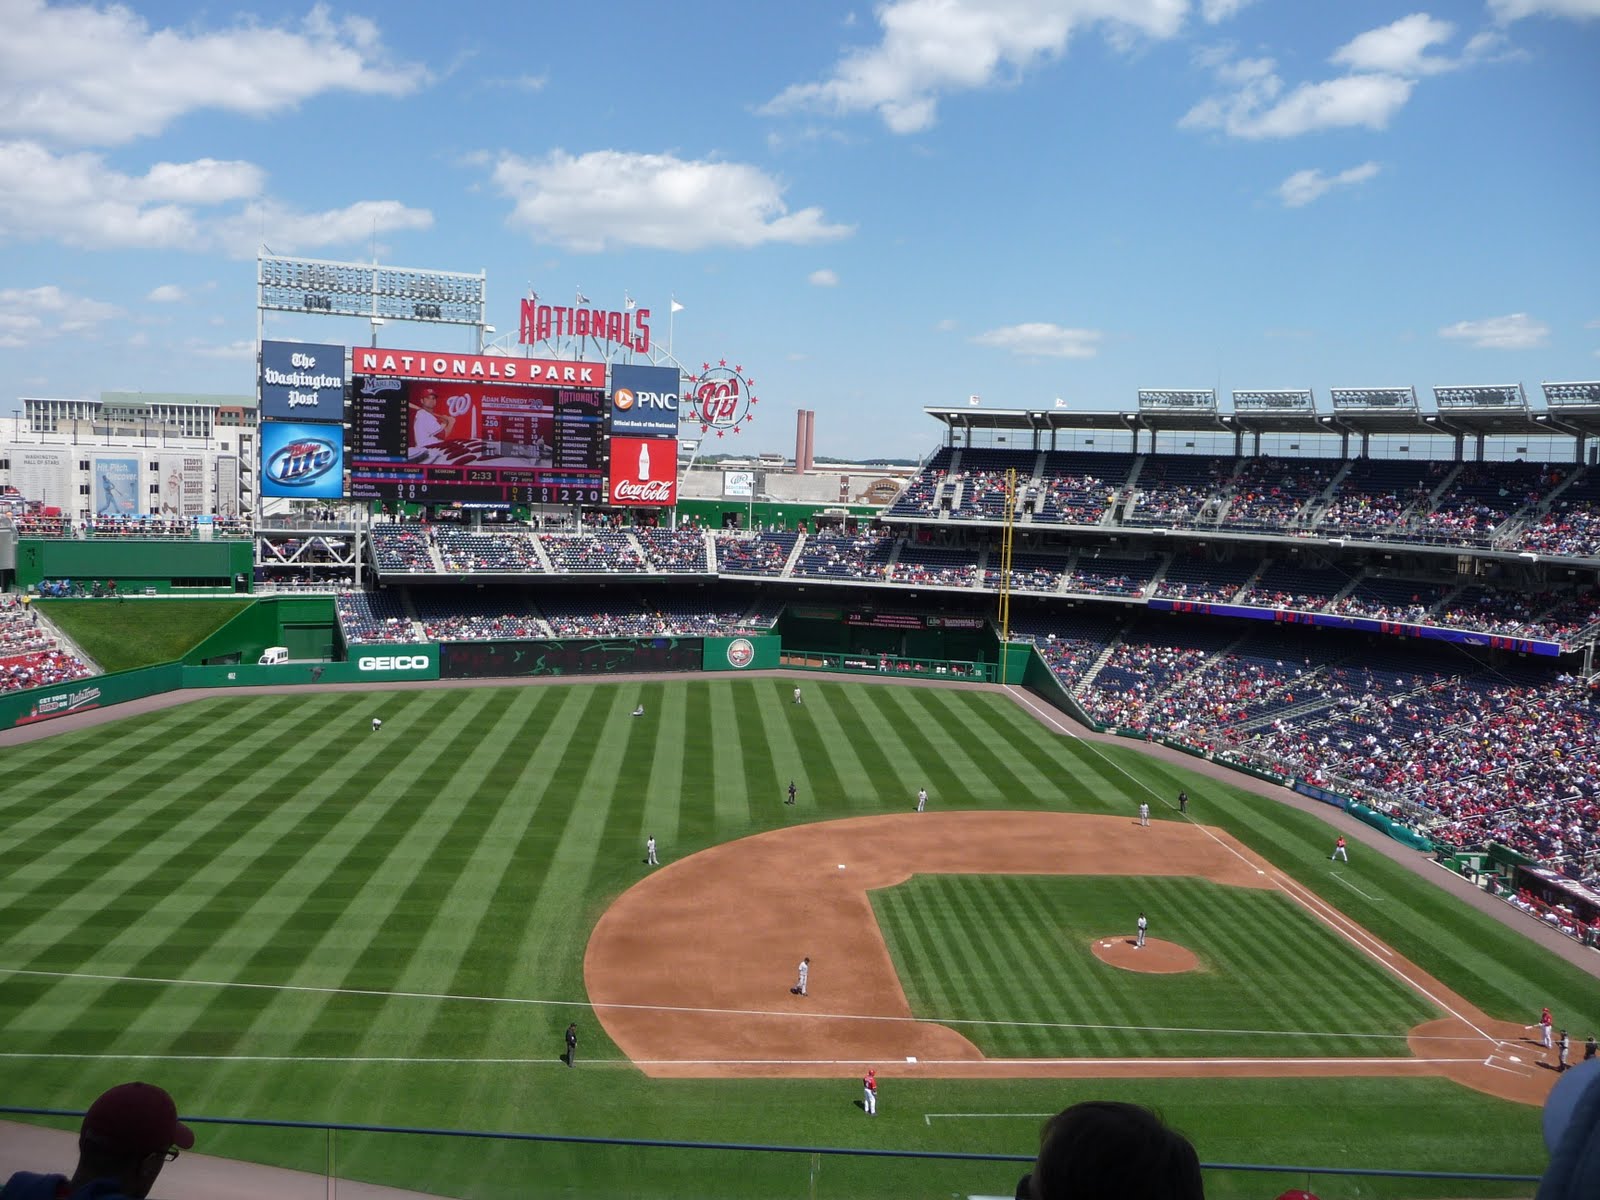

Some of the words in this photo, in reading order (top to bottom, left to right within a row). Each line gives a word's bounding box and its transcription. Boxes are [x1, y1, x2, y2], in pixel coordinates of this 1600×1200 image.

[520, 298, 650, 353] NATIONALS
[292, 352, 316, 369] The
[363, 354, 516, 377] NATIONALS
[530, 364, 592, 382] PARK
[265, 368, 342, 389] Washington
[288, 390, 318, 407] Post
[559, 390, 599, 406] NATIONALS
[636, 391, 677, 410] PNC
[288, 443, 321, 457] Miller
[279, 449, 331, 479] Lite
[562, 490, 569, 500] 2
[576, 490, 584, 500] 2
[590, 490, 598, 500] 0
[614, 480, 673, 501] Coca-Cola
[359, 656, 429, 670] GEICO
